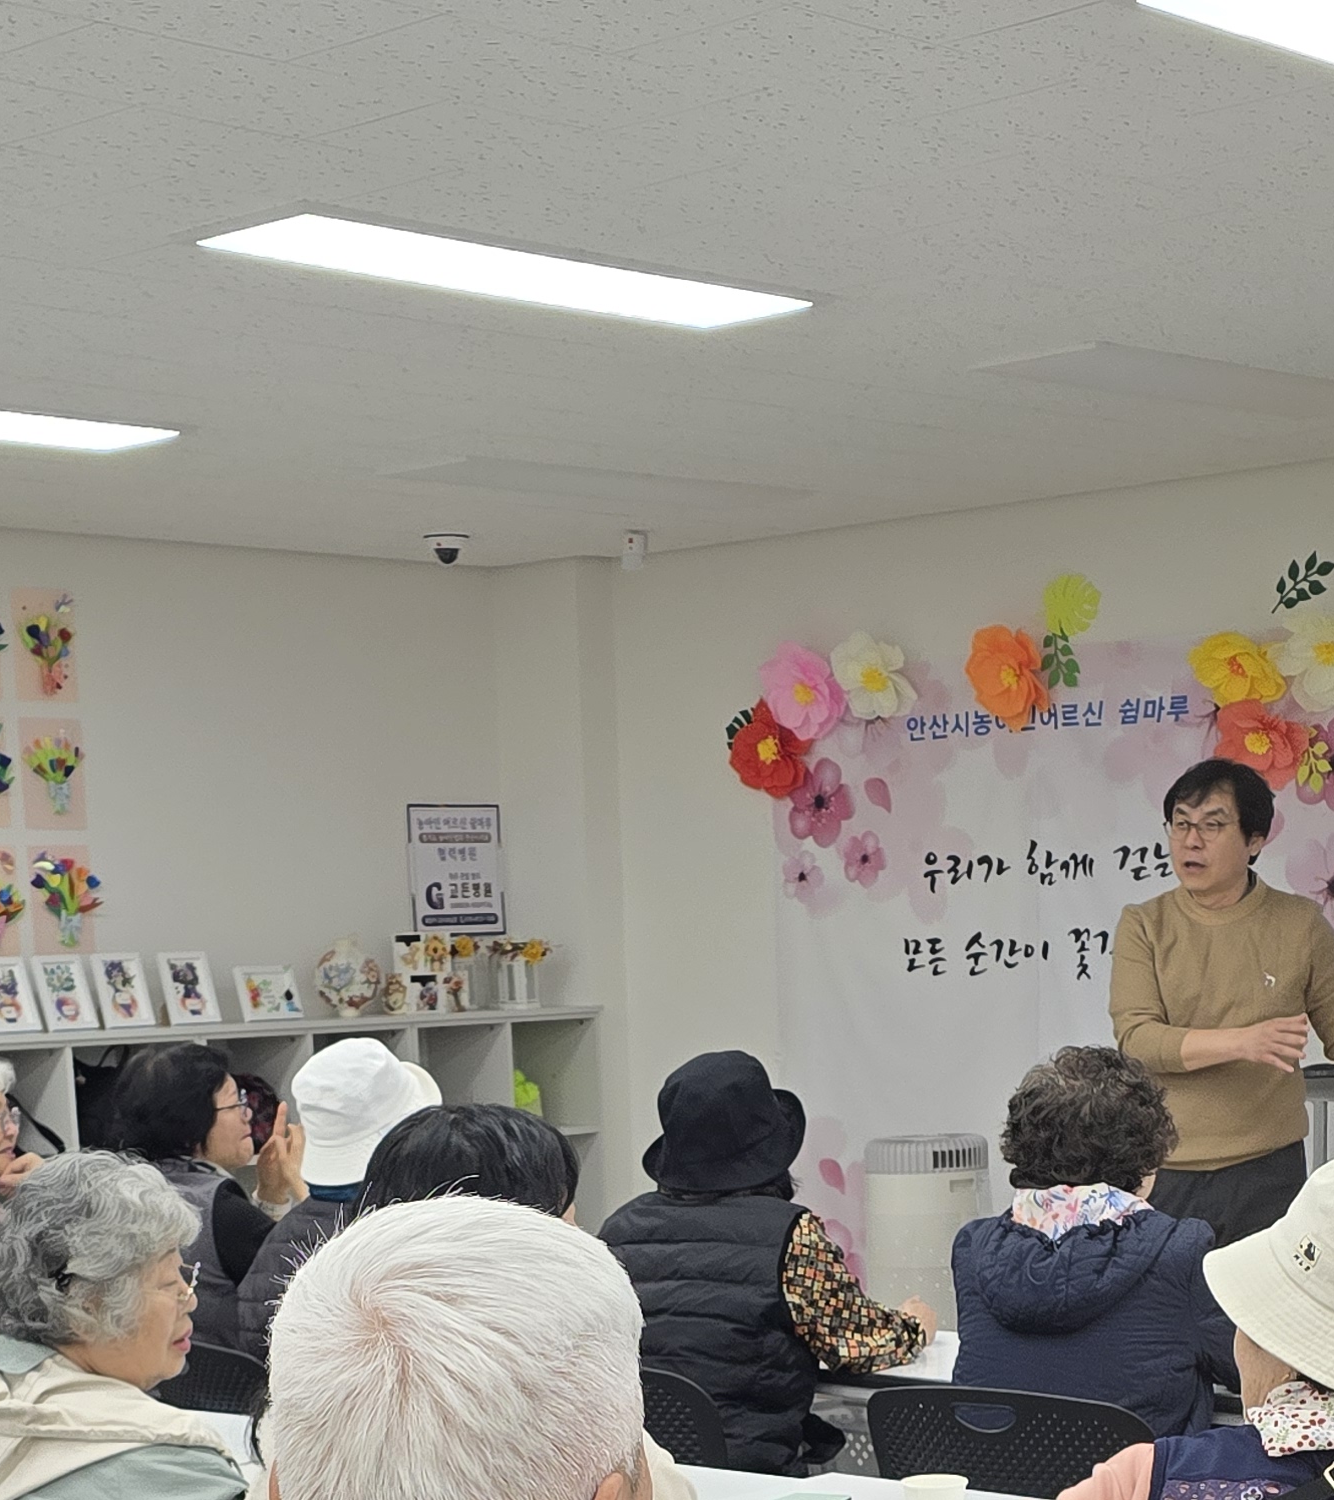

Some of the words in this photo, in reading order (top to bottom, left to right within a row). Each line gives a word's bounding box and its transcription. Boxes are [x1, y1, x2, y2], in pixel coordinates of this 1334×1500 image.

[1118, 695, 1190, 725] 쉼마루
[923, 851, 1012, 893] 우리가
[1026, 839, 1095, 886] 함께
[903, 937, 948, 976] 모든
[965, 931, 1049, 977] 순간이
